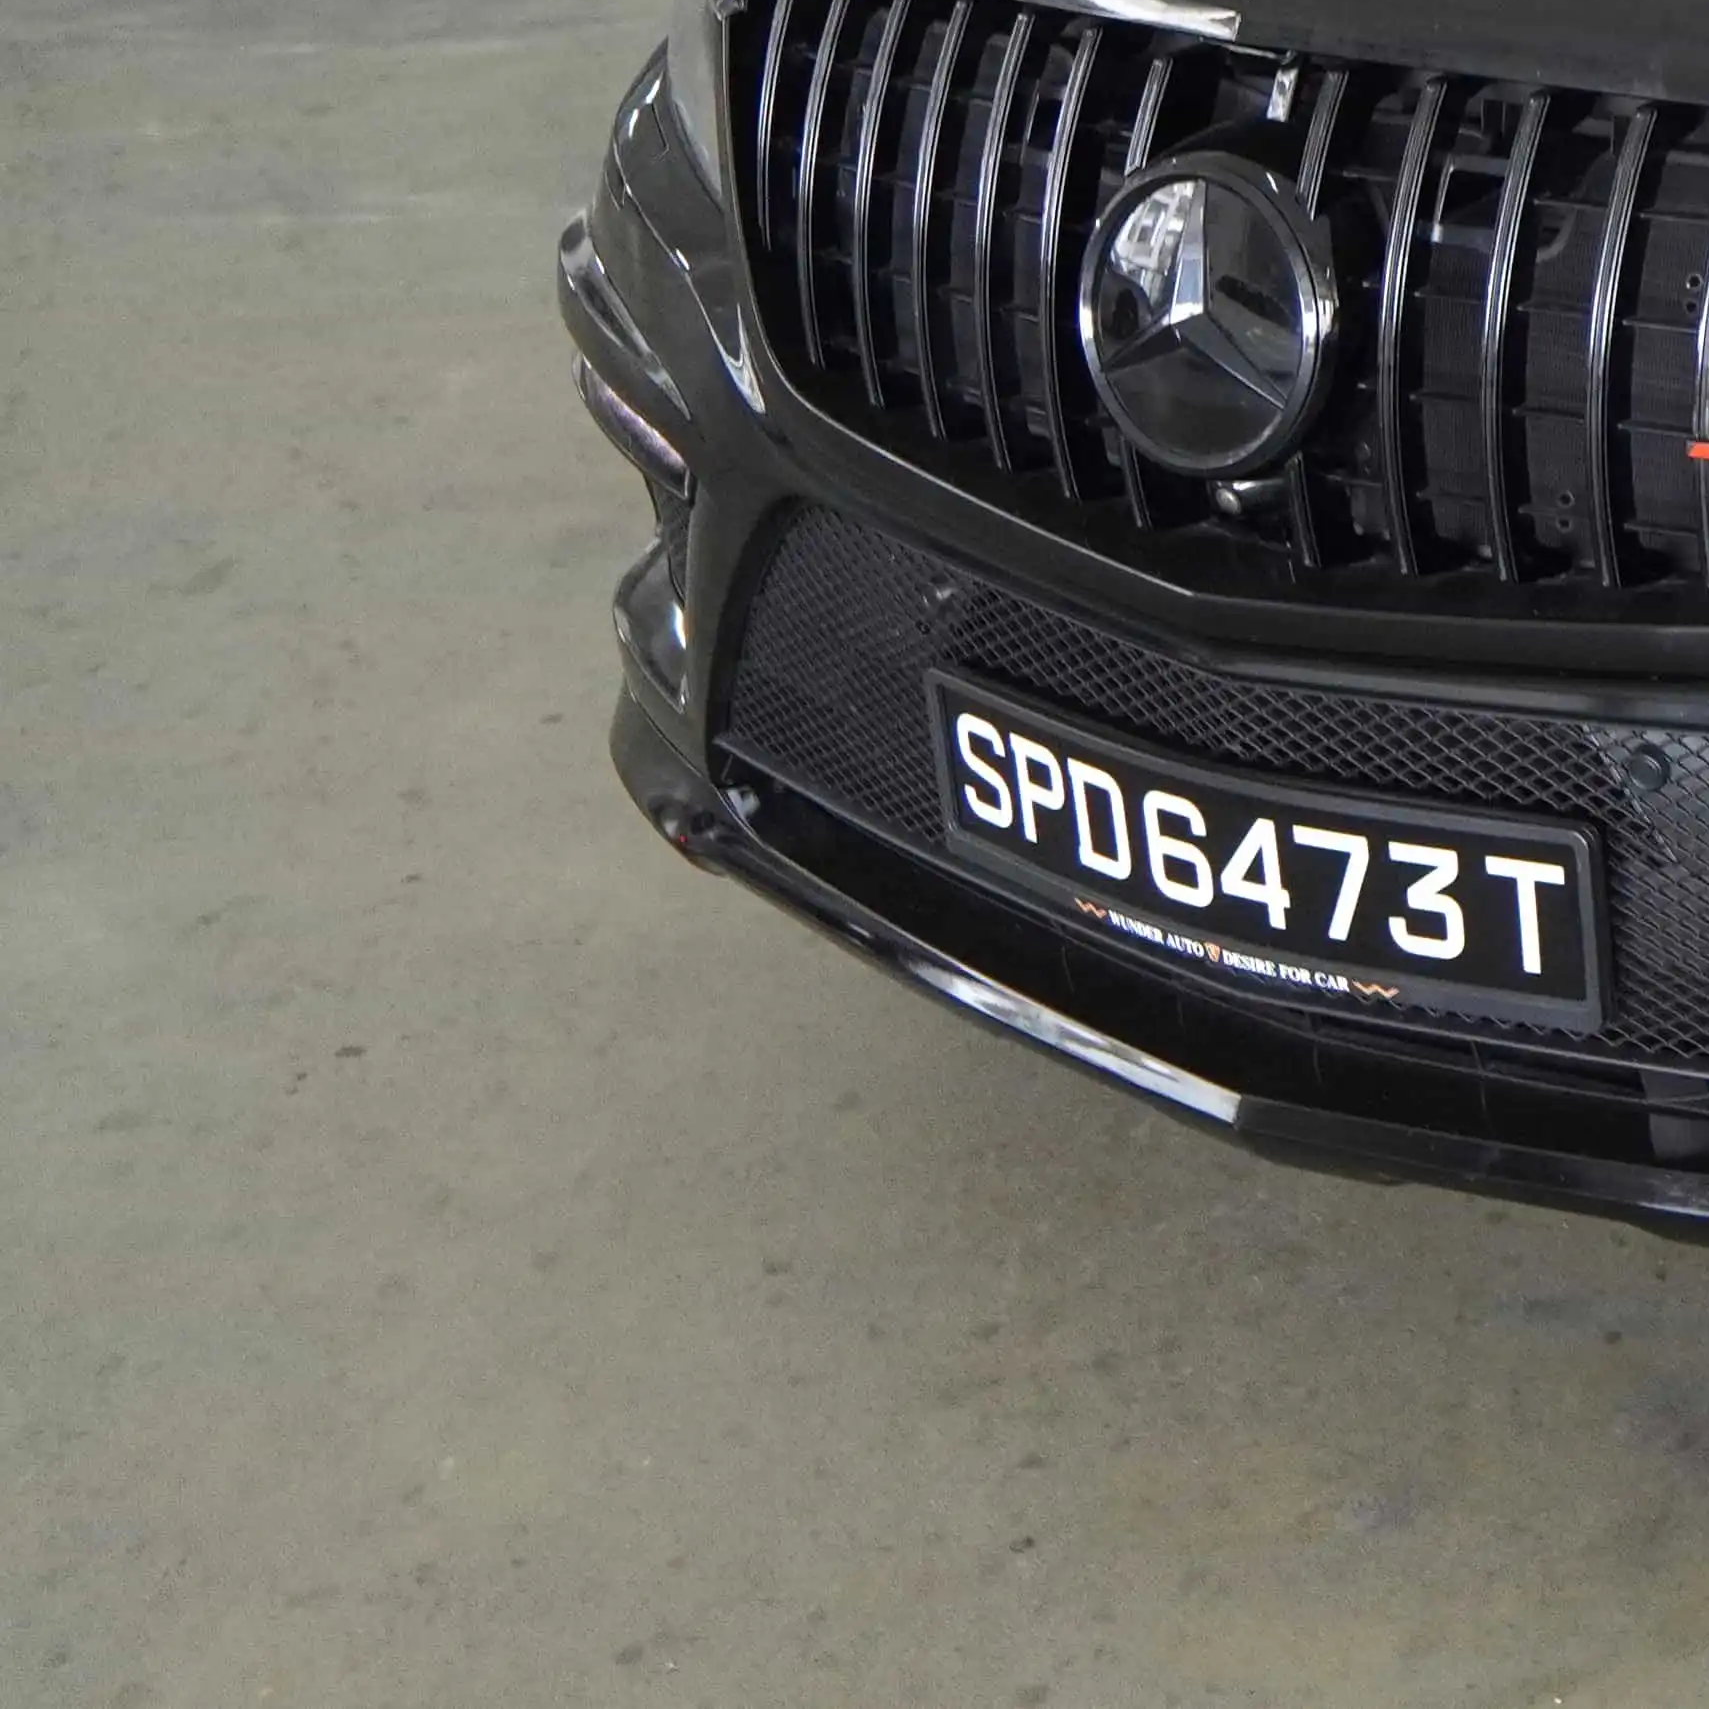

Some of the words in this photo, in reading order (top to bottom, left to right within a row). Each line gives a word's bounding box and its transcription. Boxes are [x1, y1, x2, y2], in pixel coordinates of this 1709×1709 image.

[956, 712, 1564, 975] SPD6473T
[1107, 909, 1164, 944] WUNDER
[1166, 931, 1205, 958] AUTO
[1222, 949, 1277, 976] DESIRE
[1279, 964, 1312, 985] FOR
[1314, 971, 1350, 992] CAR
